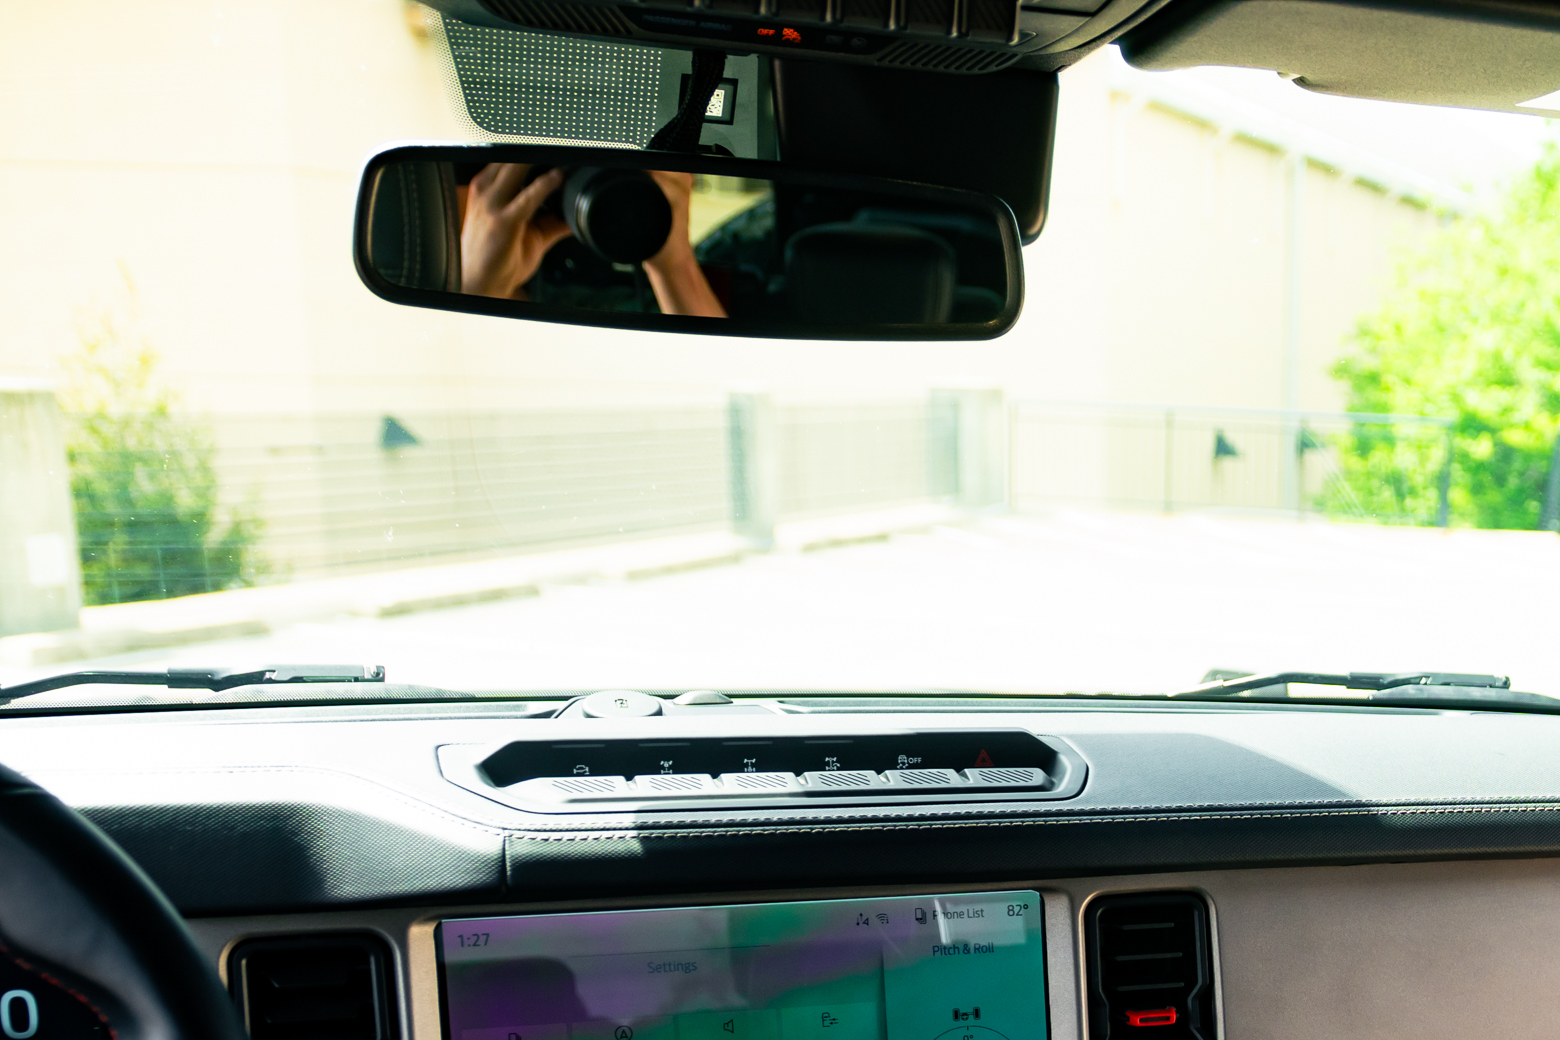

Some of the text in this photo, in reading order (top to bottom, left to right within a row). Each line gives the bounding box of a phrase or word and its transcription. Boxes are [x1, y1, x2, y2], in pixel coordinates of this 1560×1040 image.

[757, 28, 776, 36] OFF
[932, 907, 985, 920] Phone List
[1006, 904, 1029, 917] 82°
[457, 933, 490, 948] 1:27
[932, 942, 995, 956] Pitch & Roll
[647, 960, 698, 975] Settings
